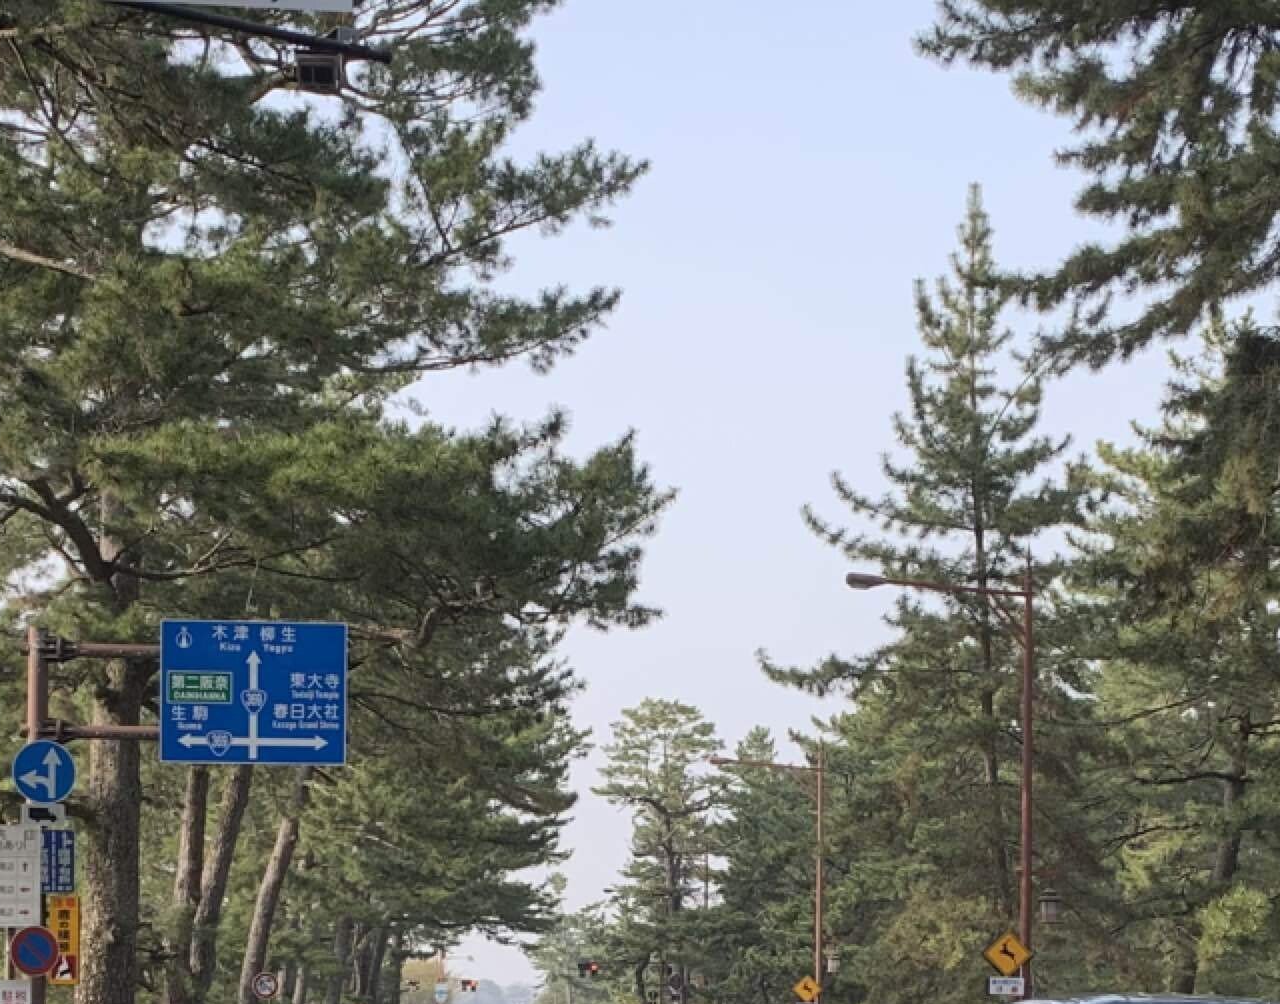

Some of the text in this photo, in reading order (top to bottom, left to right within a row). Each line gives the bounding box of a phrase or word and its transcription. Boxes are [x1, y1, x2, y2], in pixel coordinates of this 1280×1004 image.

[211, 625, 297, 643] 木津 柳生
[290, 672, 339, 688] 東大寺
[171, 705, 209, 721] 生駒
[272, 703, 339, 720] 春日大社
